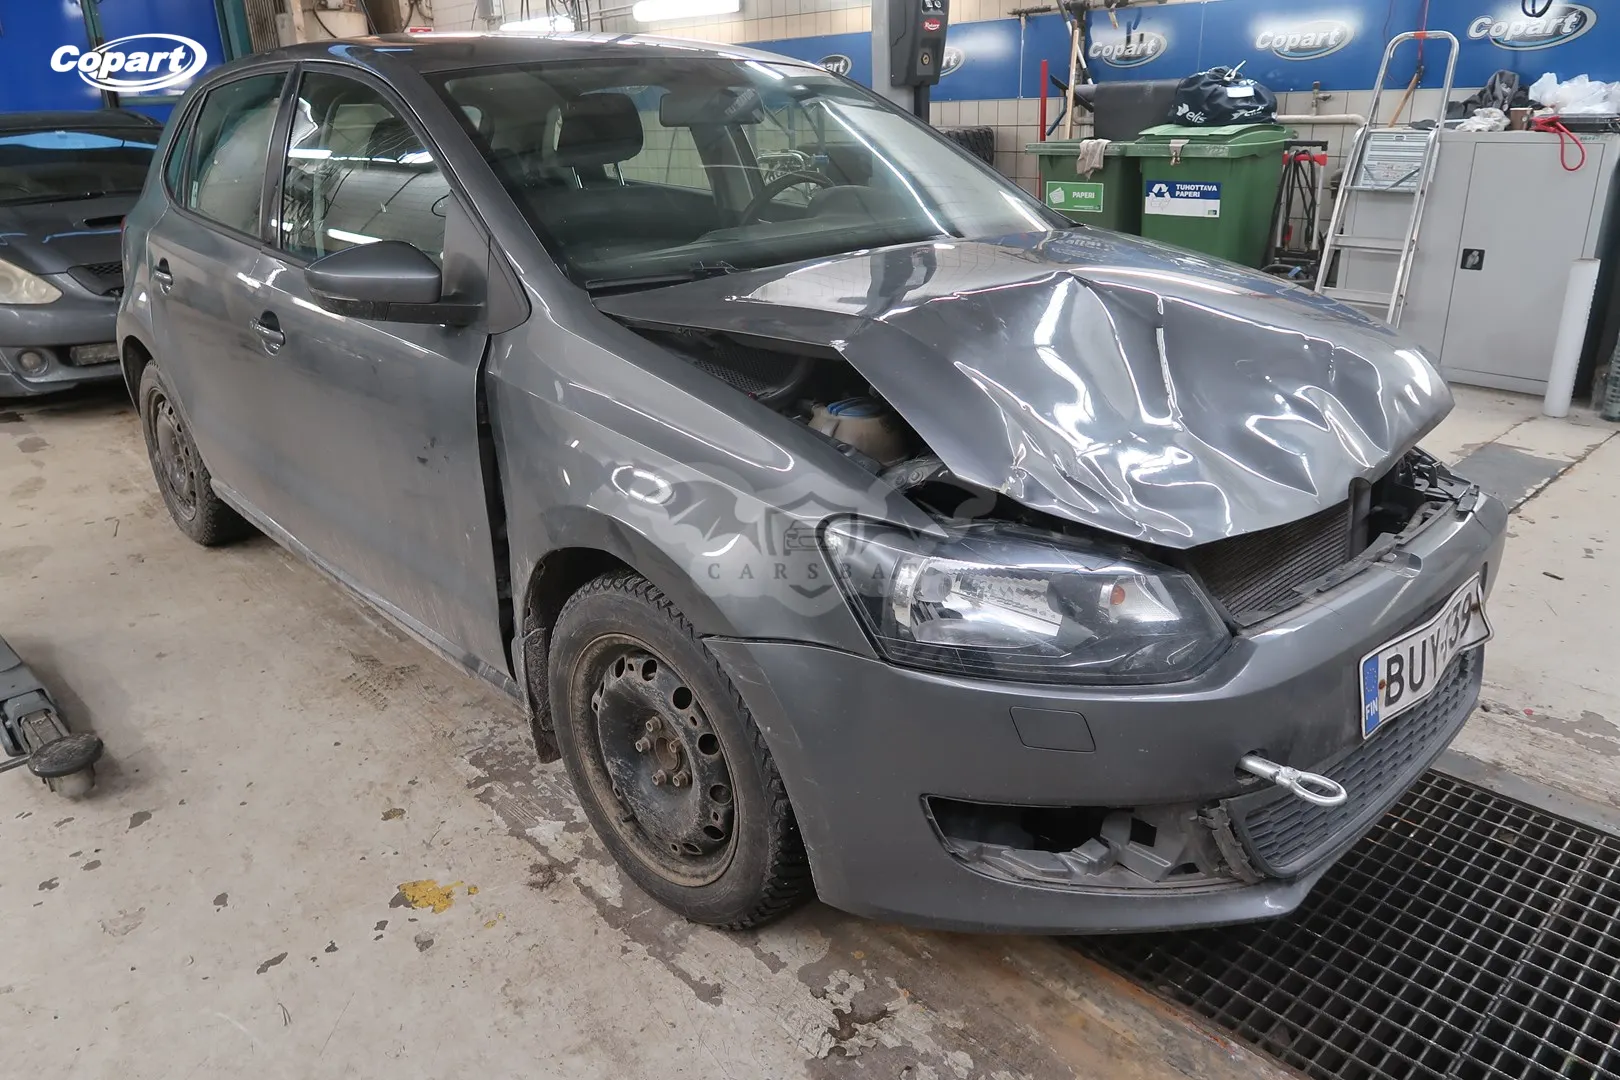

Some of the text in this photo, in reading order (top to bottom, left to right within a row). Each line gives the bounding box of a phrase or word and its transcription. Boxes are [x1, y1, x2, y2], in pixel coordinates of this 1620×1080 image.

[1467, 9, 1581, 42] Copart
[1088, 38, 1158, 61] Copart
[1255, 27, 1341, 52] Copart
[1072, 191, 1096, 199] PAPERI
[1175, 183, 1217, 192] TUHOTTAVA
[1175, 190, 1200, 198] PAPERI
[1384, 592, 1472, 707] BUY-139
[1365, 698, 1379, 720] FIN
